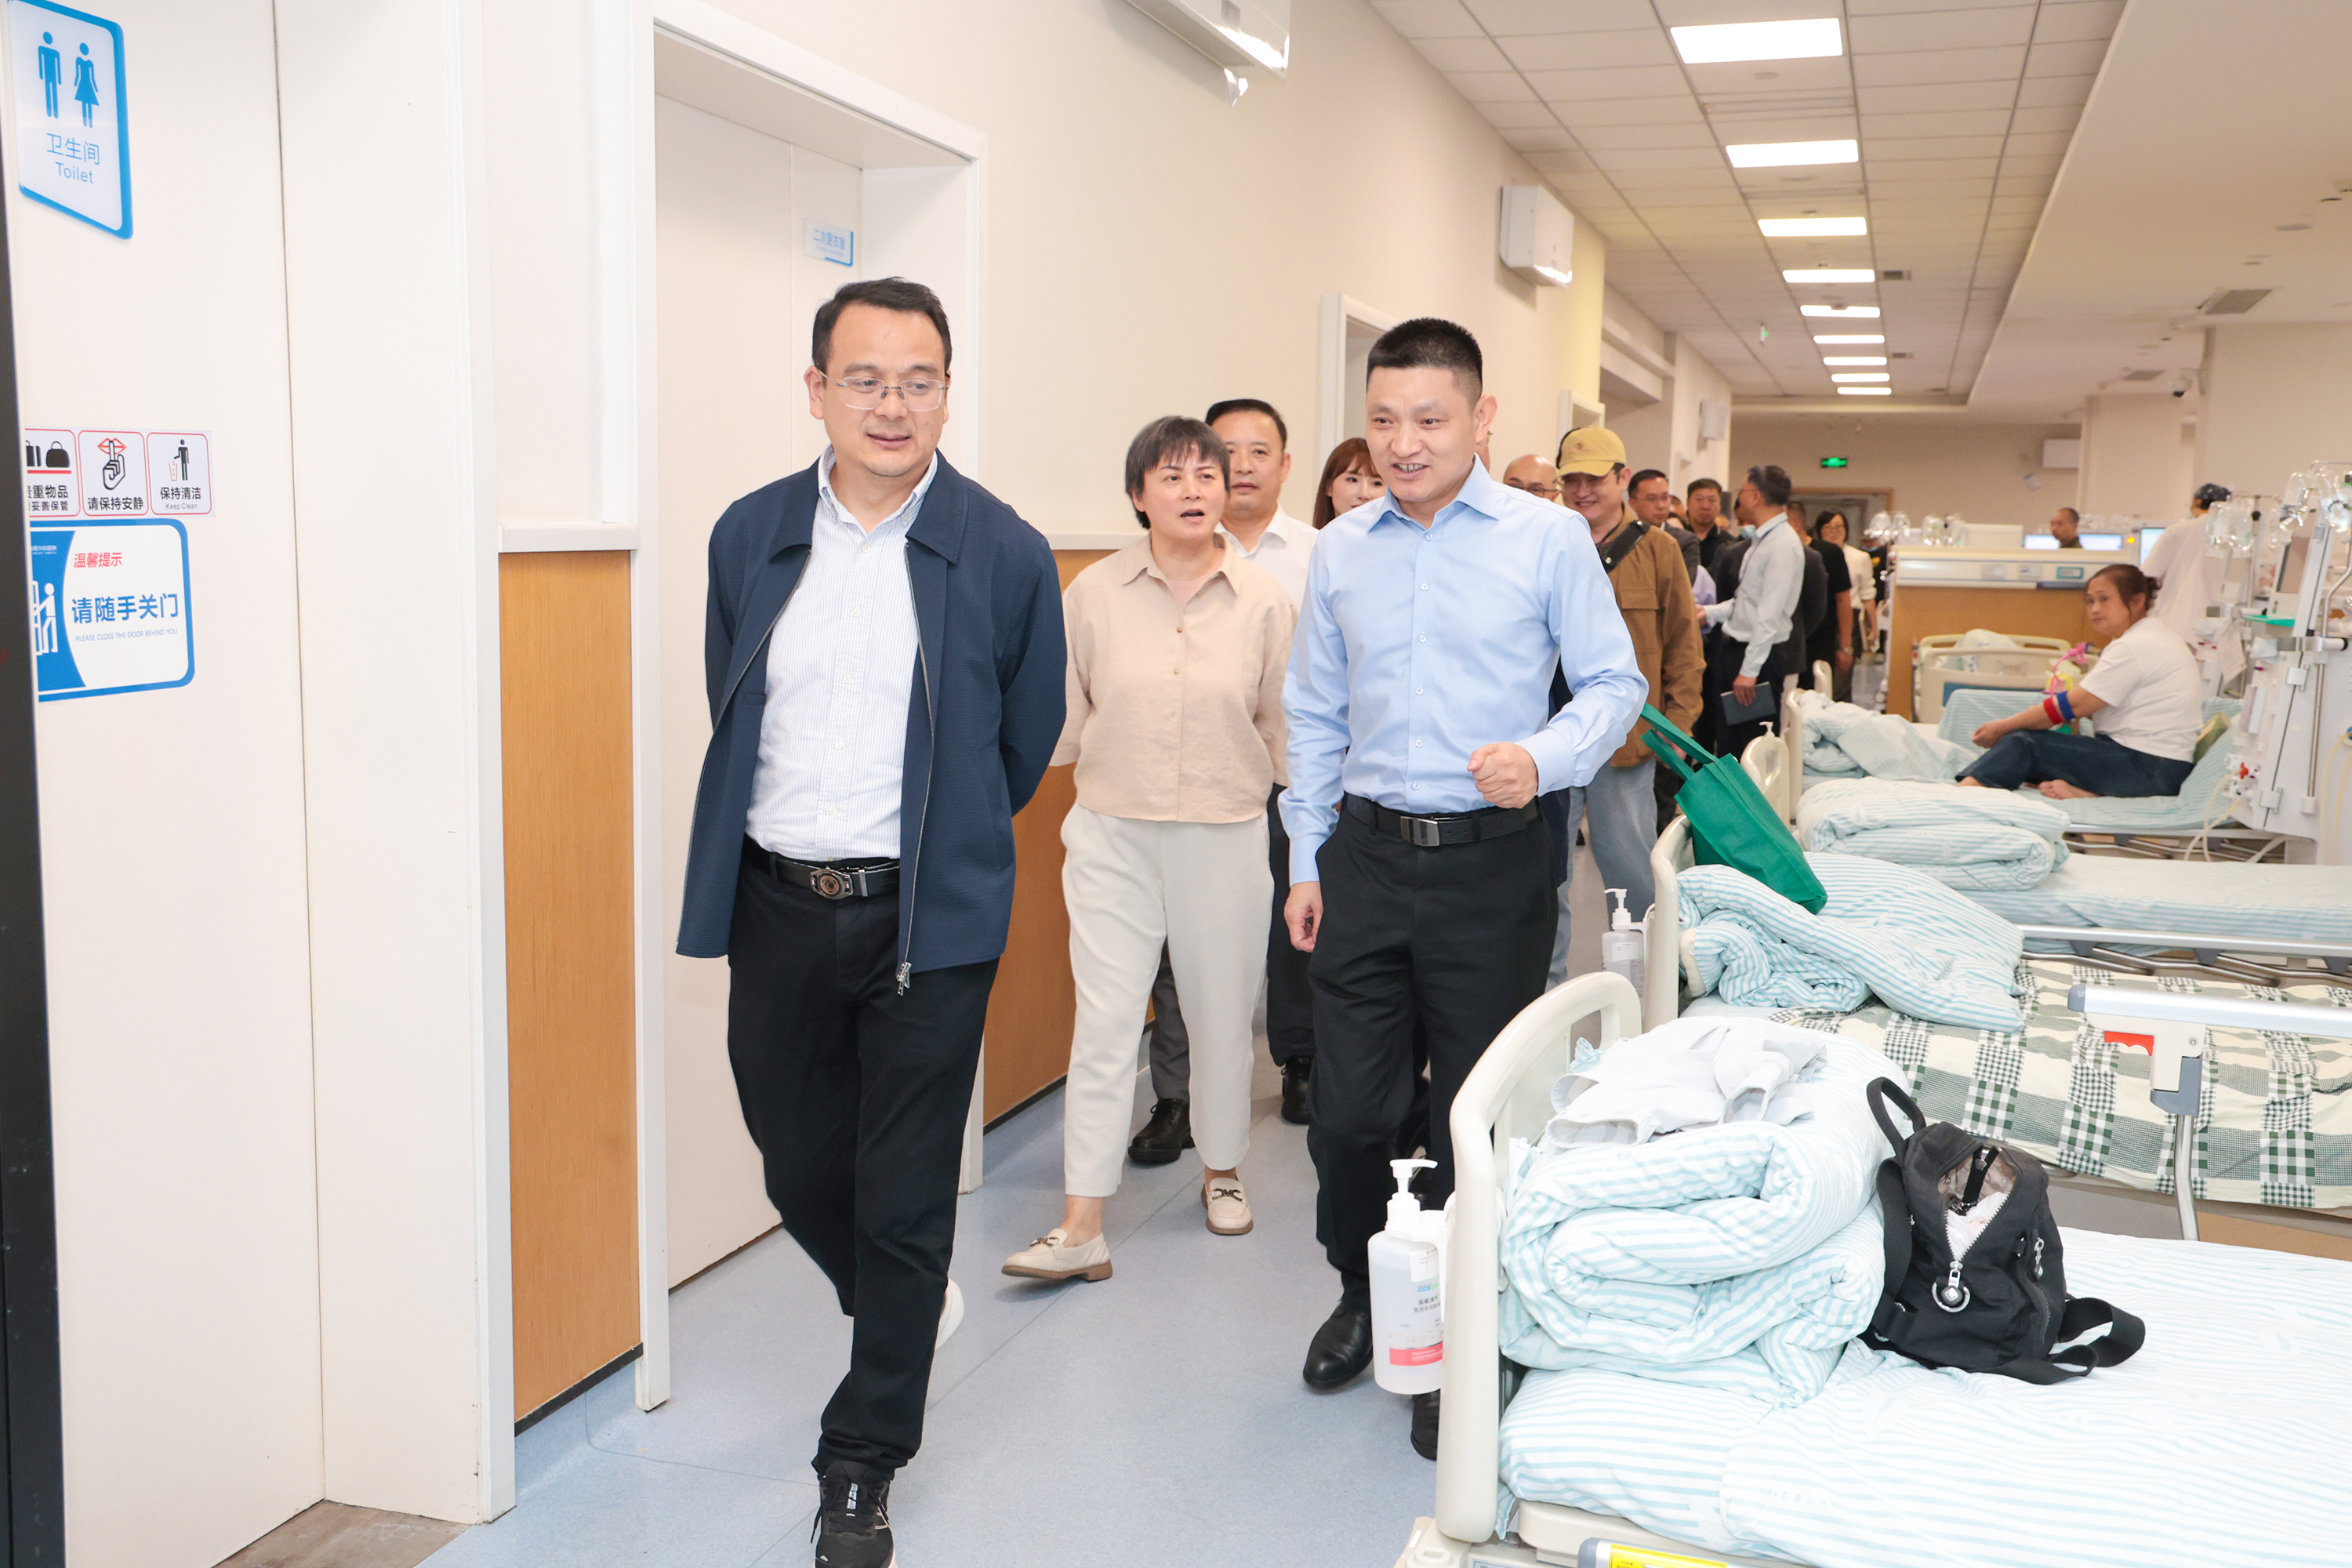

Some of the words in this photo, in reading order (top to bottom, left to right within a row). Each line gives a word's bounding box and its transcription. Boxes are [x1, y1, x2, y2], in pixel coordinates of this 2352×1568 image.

[46, 132, 100, 165] 卫生间
[55, 162, 93, 183] Toilet
[160, 486, 201, 500] 保持清洁
[28, 500, 69, 511] 妥善保管
[88, 497, 144, 510] 请保持安静
[74, 552, 123, 568] 温馨提示
[71, 593, 180, 624] 请随手关门
